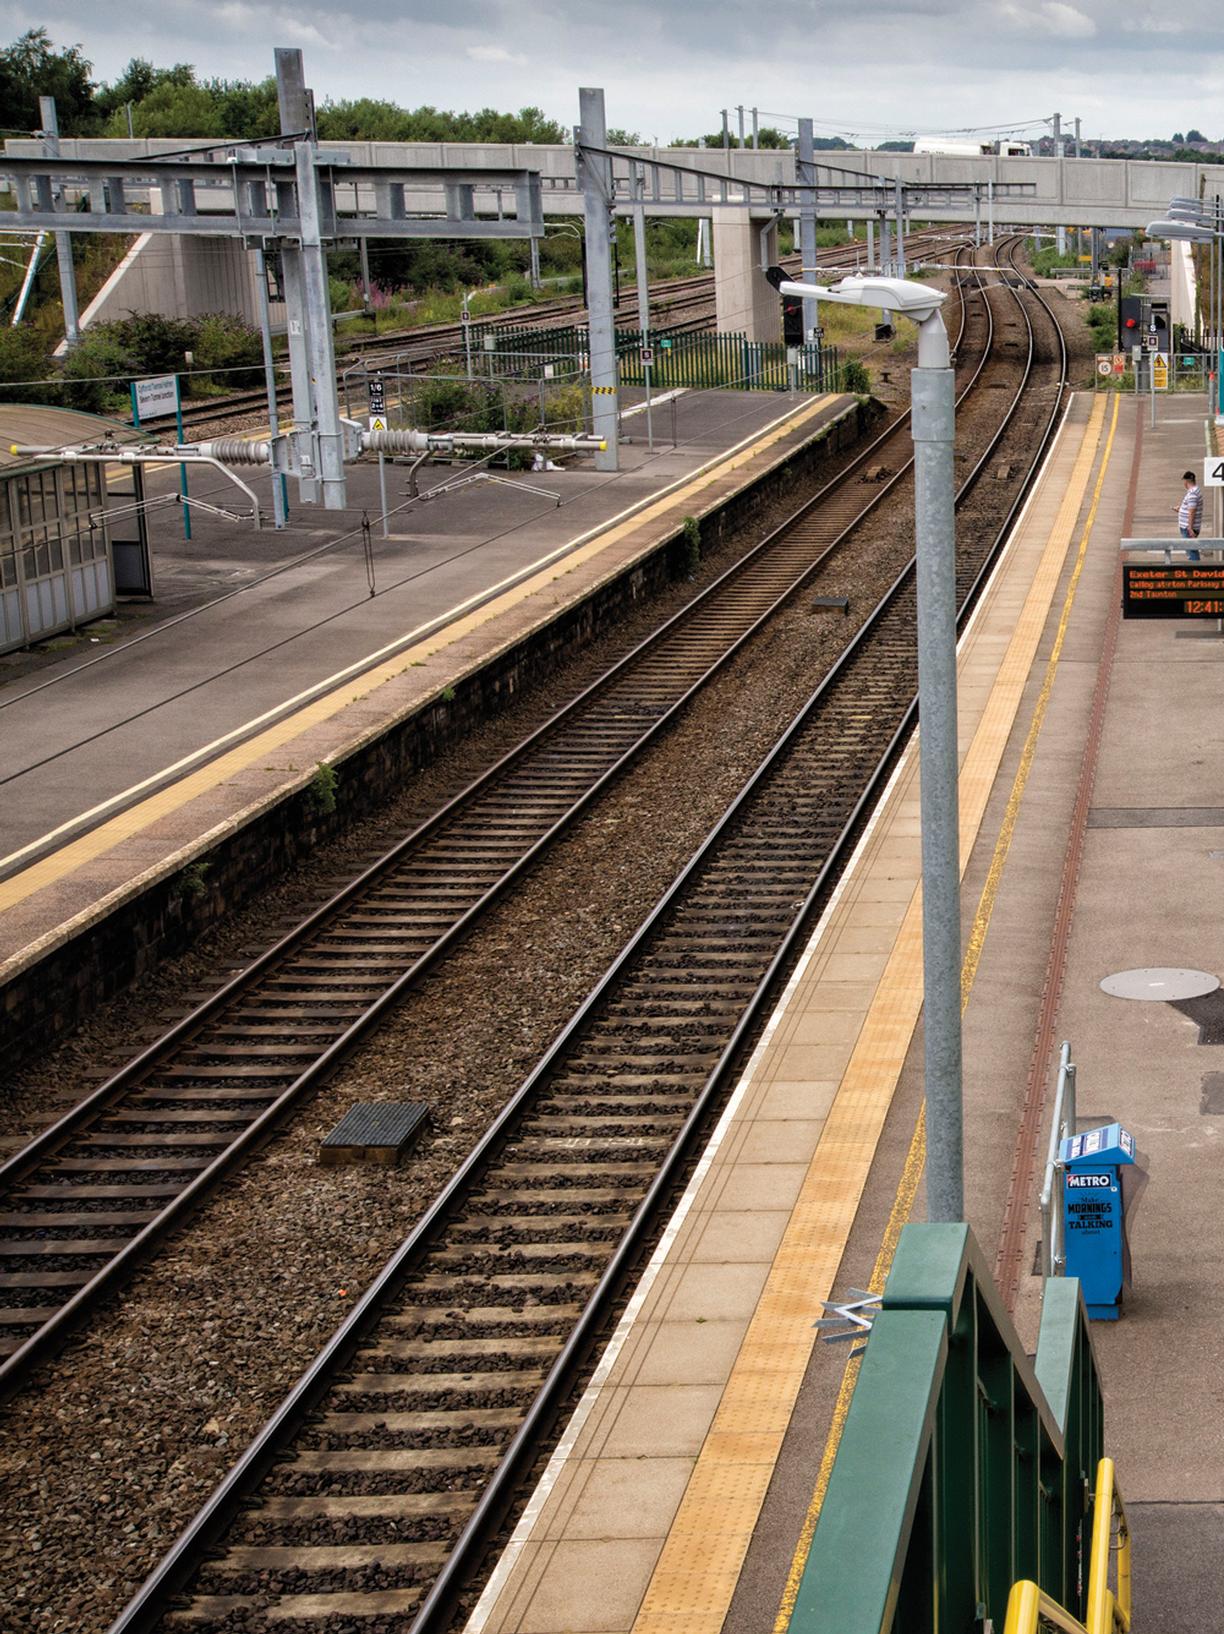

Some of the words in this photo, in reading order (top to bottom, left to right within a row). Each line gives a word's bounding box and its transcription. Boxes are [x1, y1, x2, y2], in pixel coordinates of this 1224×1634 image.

[1129, 570, 1168, 579] Exeter
[1174, 570, 1187, 578] St
[1069, 1175, 1110, 1187] METRO
[1068, 1203, 1112, 1214] MORNINGS
[1069, 1220, 1113, 1229] TALKING
